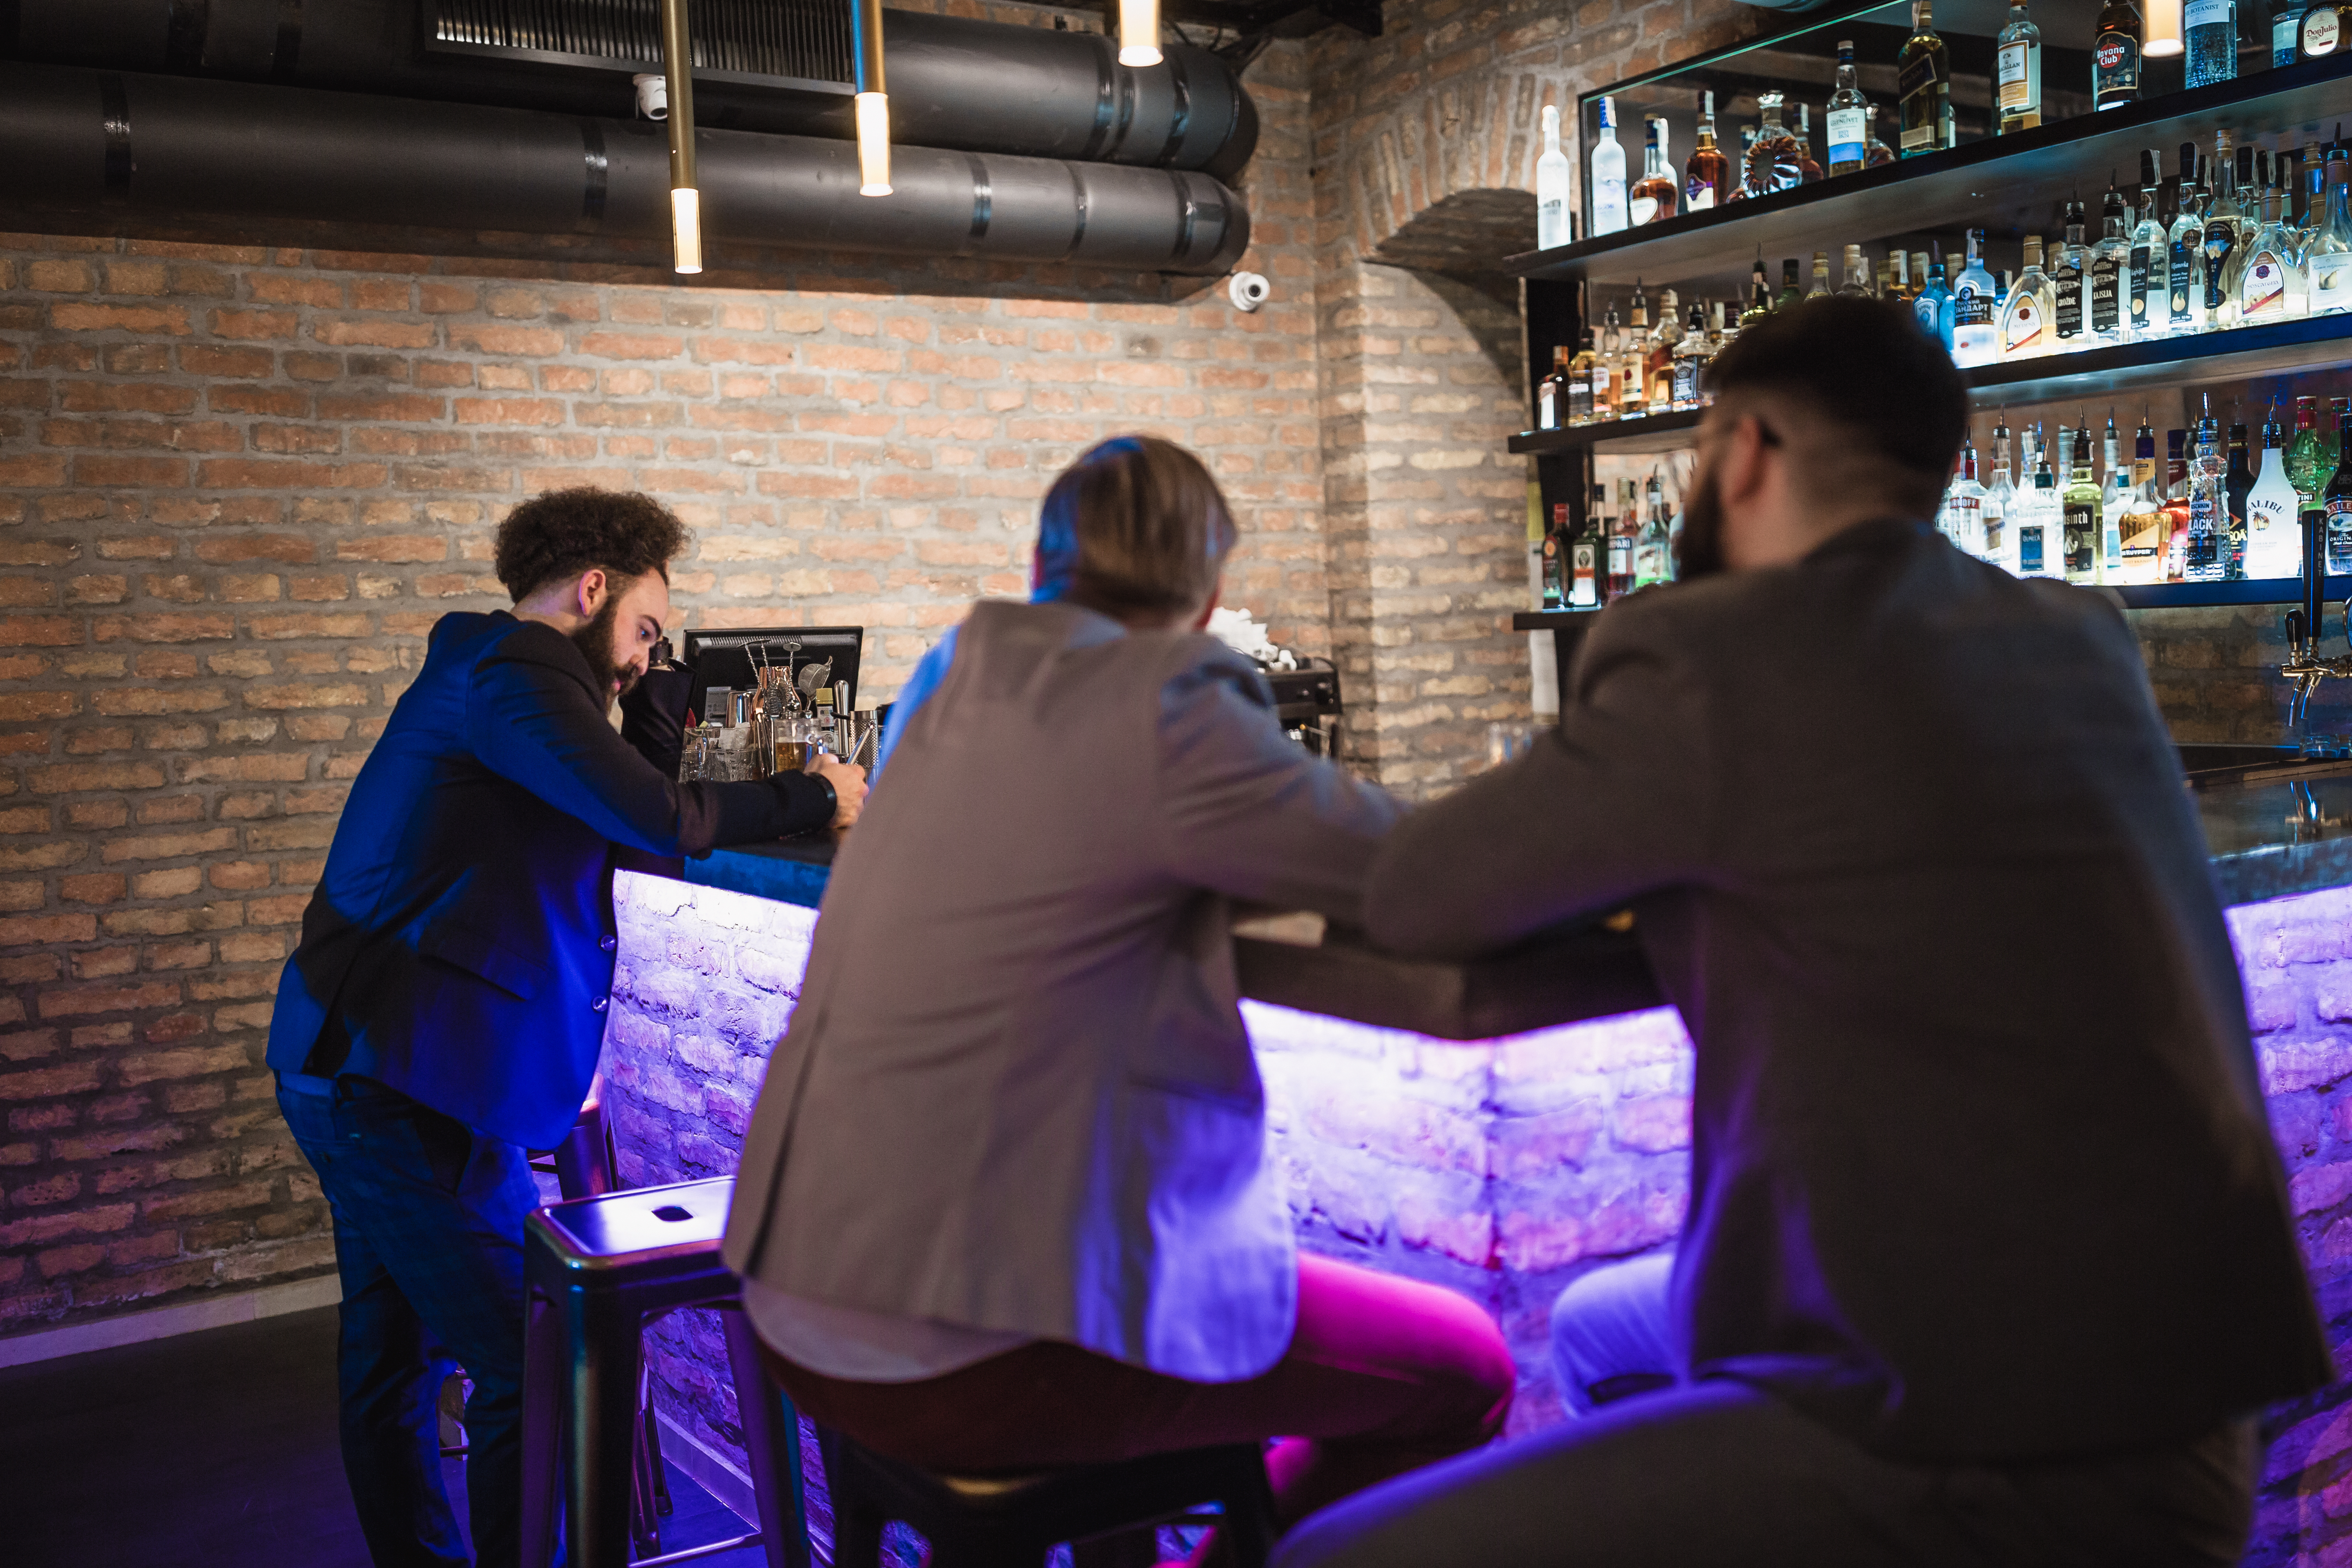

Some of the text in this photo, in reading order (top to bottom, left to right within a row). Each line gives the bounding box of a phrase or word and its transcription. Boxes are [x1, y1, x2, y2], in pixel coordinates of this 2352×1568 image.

[2191, 4, 2219, 14] BOTANIST
[2097, 47, 2125, 59] Havana
[2101, 55, 2118, 65] Club
[2094, 290, 2112, 300] KAJSIJA
[1956, 304, 1988, 314] ТАНДАРТ
[2327, 503, 2352, 514] BAILE
[2189, 519, 2213, 530] LACK
